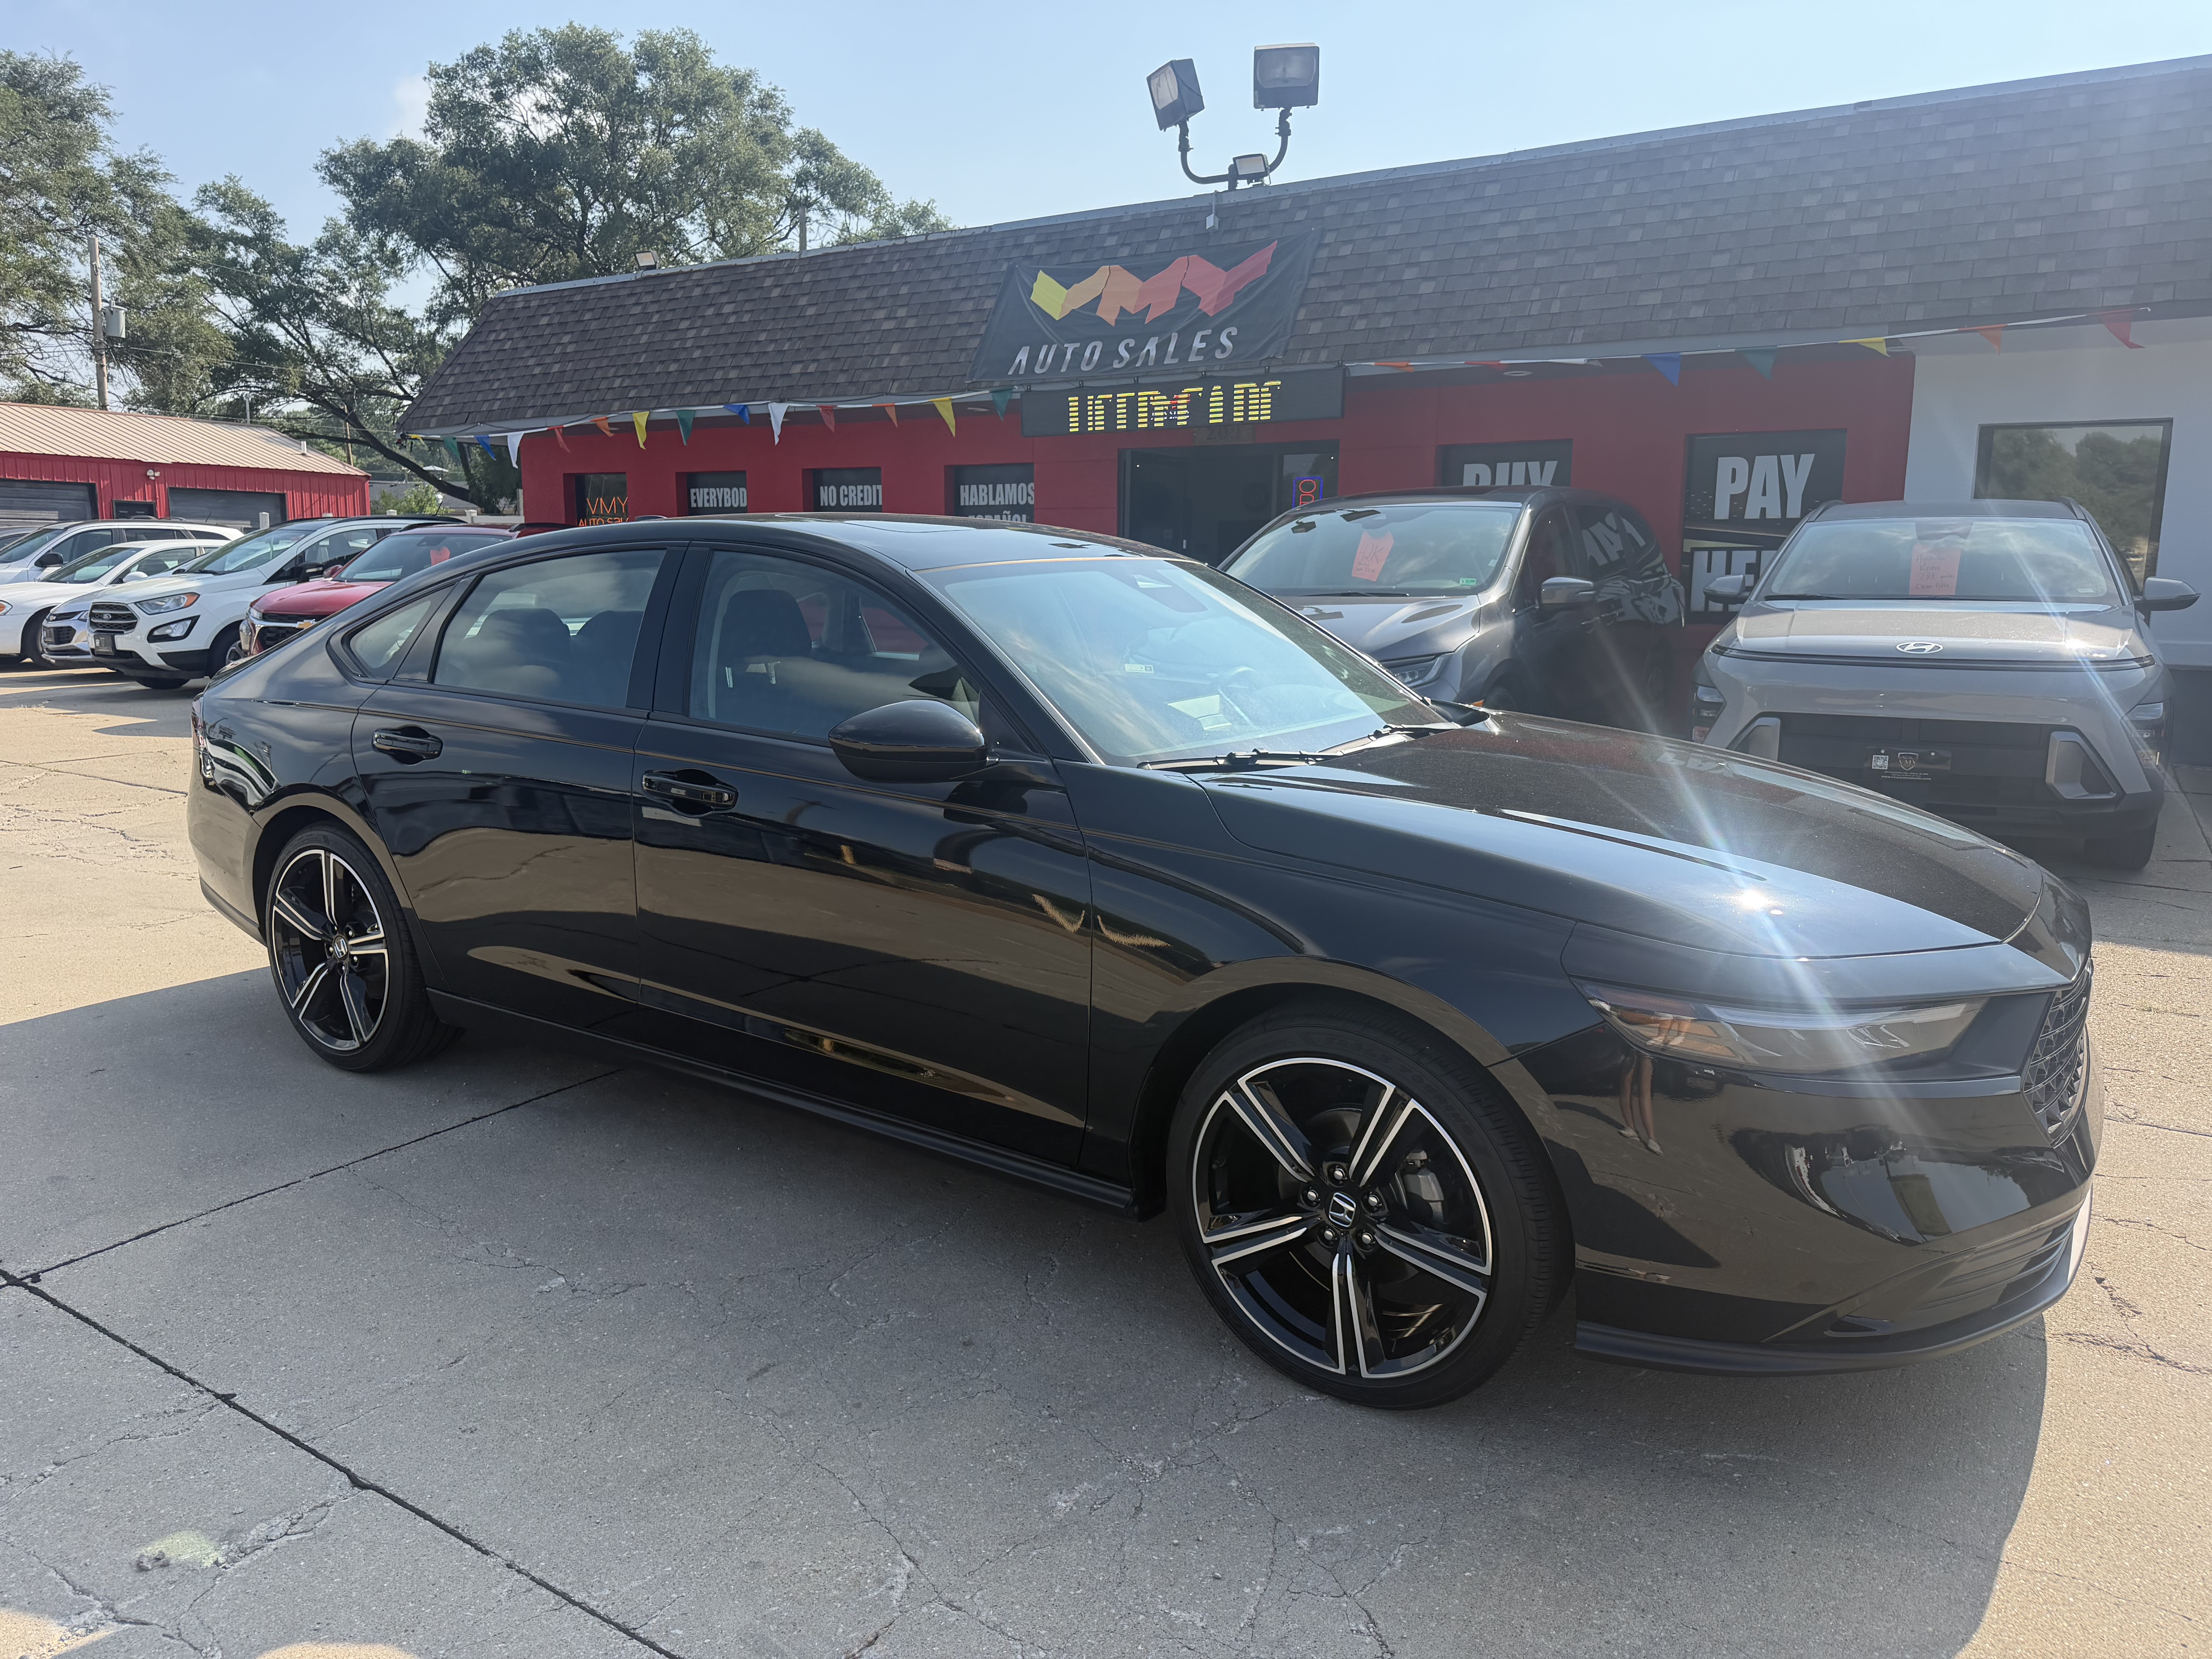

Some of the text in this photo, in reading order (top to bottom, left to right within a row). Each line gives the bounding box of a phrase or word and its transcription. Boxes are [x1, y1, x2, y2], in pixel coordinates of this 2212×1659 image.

[1008, 327, 1238, 376] AUTO SALES
[820, 485, 882, 506] NO CREDIT
[960, 483, 1035, 506] HABLAMOS
[1714, 453, 1815, 520] PAY
[586, 497, 628, 514] VMY
